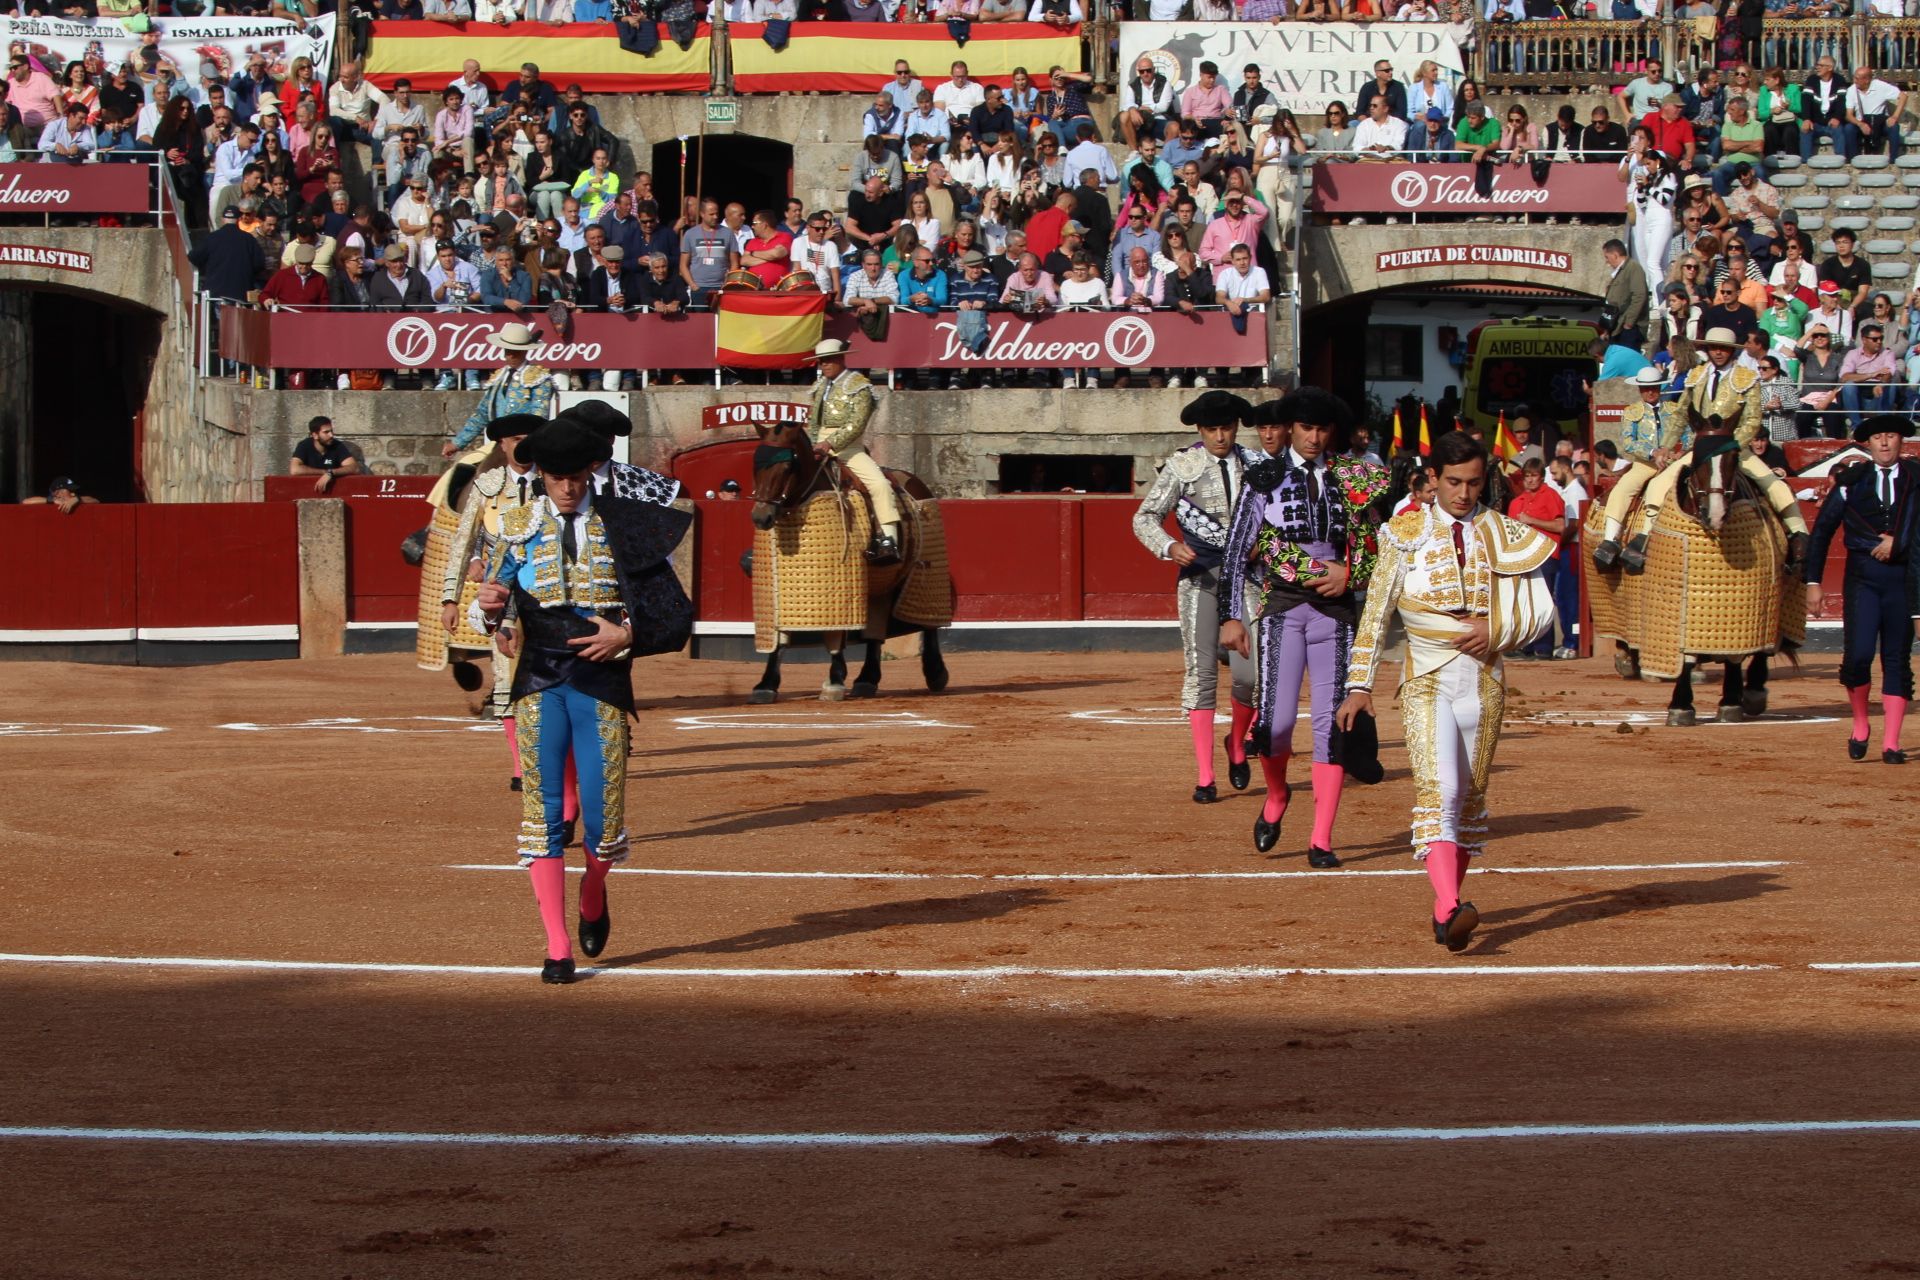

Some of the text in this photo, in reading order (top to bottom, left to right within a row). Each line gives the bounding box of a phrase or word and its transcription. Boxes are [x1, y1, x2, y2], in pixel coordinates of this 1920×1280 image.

[8, 19, 304, 38] PEÑA TAURINA ISMAEL MARTÍN
[1217, 29, 1440, 57] JVVENTVD
[1262, 65, 1413, 94] AVRIA
[708, 106, 735, 119] SALIDA
[0, 247, 91, 270] ARRASTRE
[1379, 247, 1568, 269] PUERTA DE CUADRILLAS
[1489, 341, 1591, 356] AMBULANCIA
[716, 404, 809, 425] TORILE
[380, 479, 397, 493] 12
